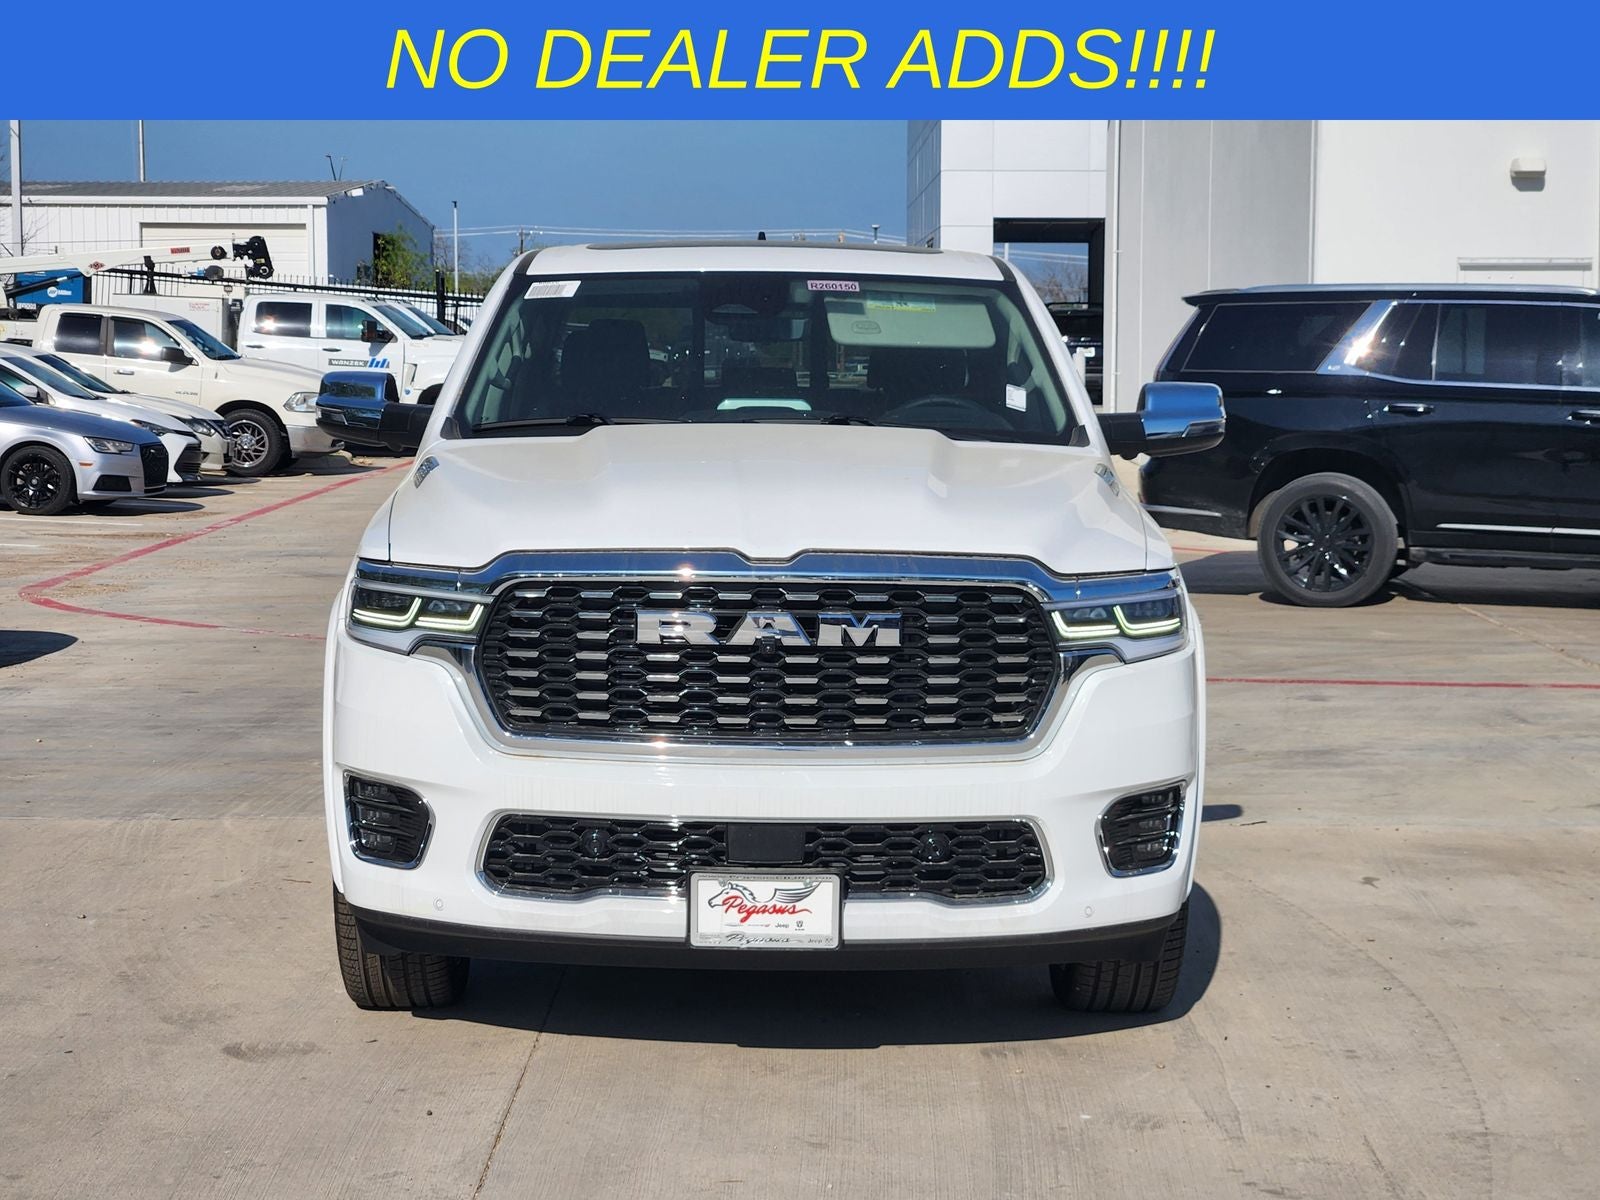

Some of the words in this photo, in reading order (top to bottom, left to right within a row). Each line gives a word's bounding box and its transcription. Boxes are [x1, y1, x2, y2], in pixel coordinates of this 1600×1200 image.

[810, 282, 857, 291] R260150
[636, 609, 902, 647] RAM
[722, 895, 813, 923] Pegasus
